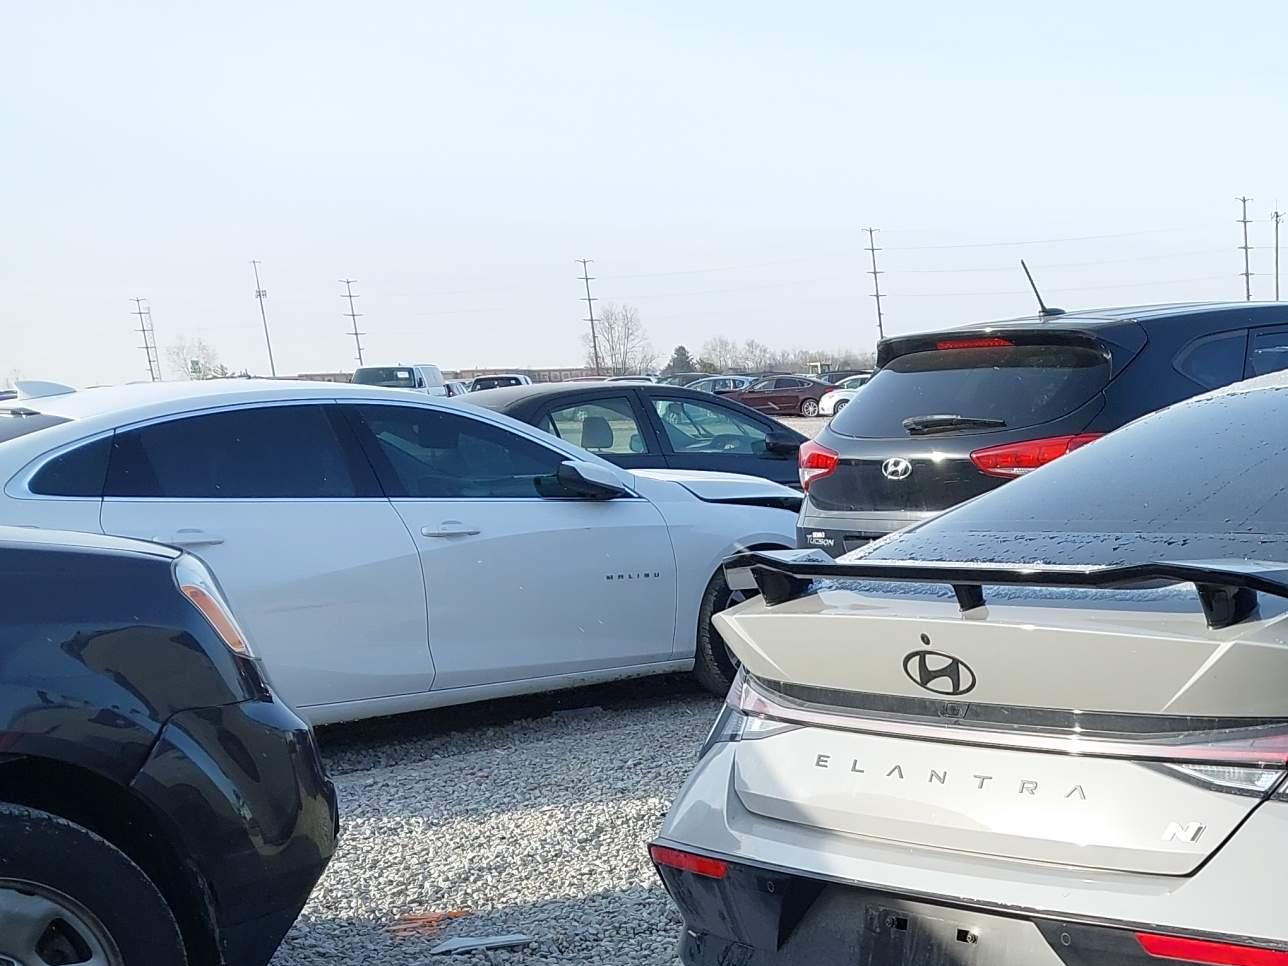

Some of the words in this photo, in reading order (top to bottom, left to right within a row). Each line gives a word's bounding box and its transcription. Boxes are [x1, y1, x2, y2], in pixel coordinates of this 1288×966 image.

[806, 534, 834, 546] TUCSON
[606, 573, 660, 581] MALIBU
[814, 753, 1088, 801] ELANTRA
[1162, 821, 1206, 844] N
